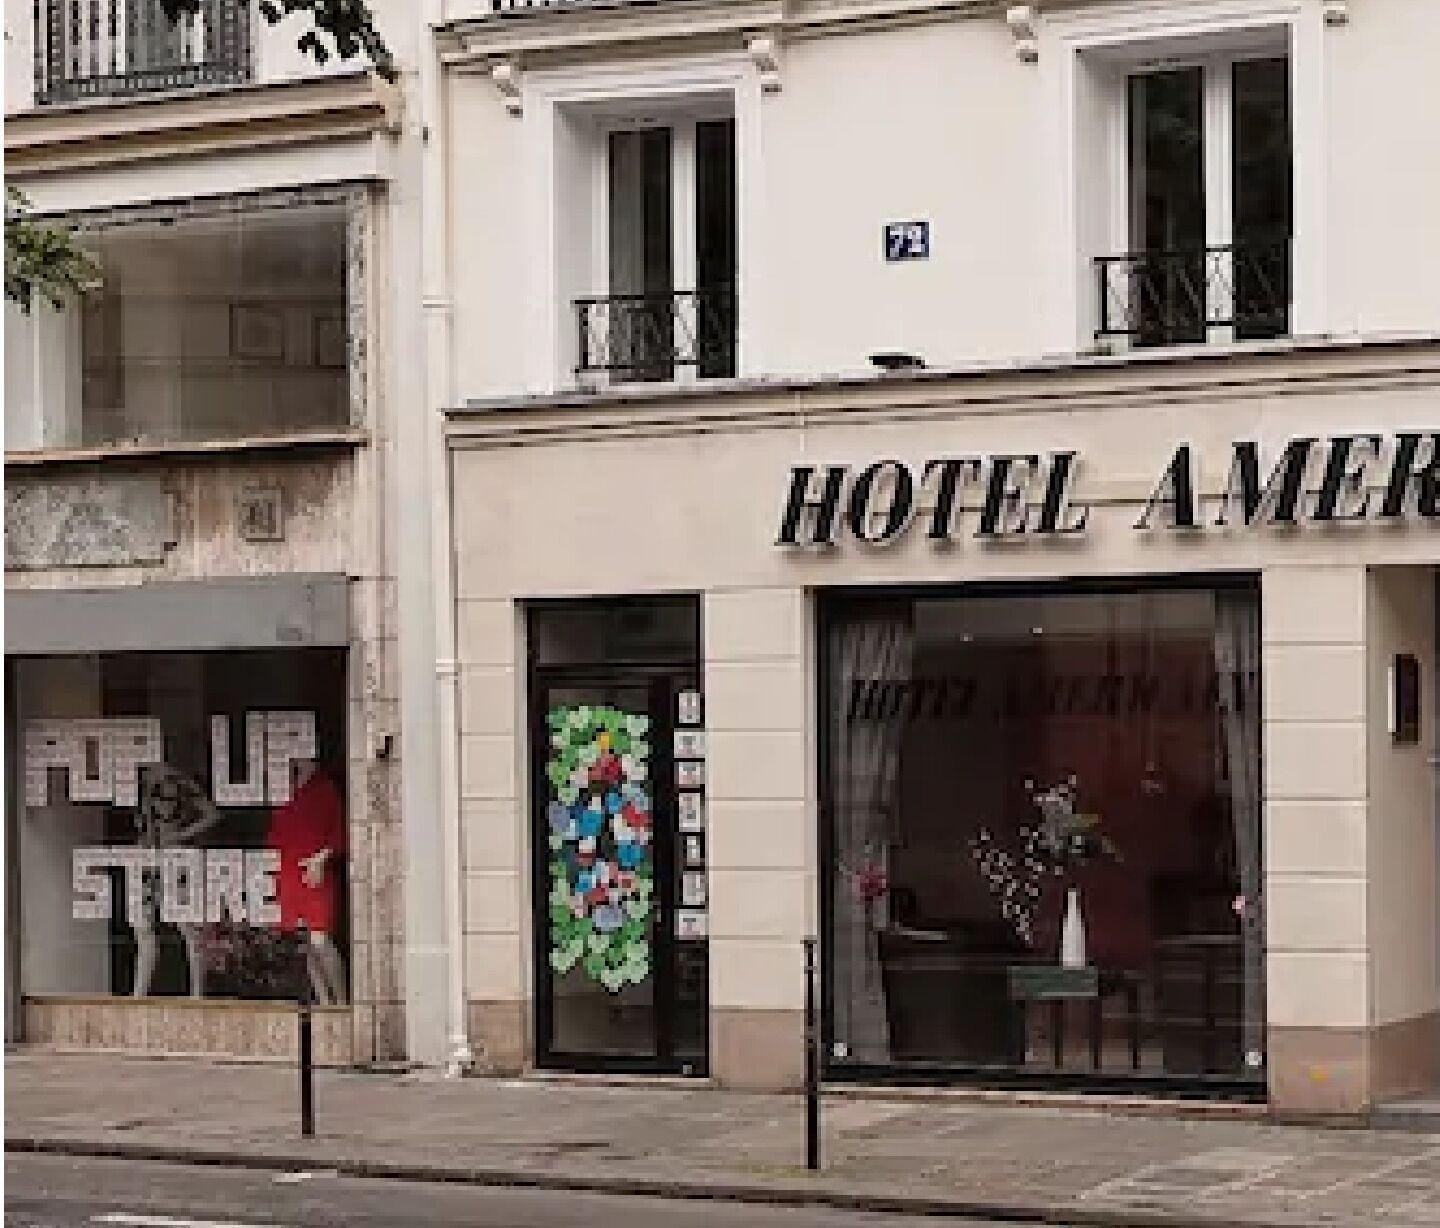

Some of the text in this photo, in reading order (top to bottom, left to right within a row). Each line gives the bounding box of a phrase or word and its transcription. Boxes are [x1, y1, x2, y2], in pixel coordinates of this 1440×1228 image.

[889, 225, 925, 259] 72
[774, 449, 1091, 548] HOTEL
[25, 710, 317, 807] POP UP
[72, 848, 282, 925] STORE
